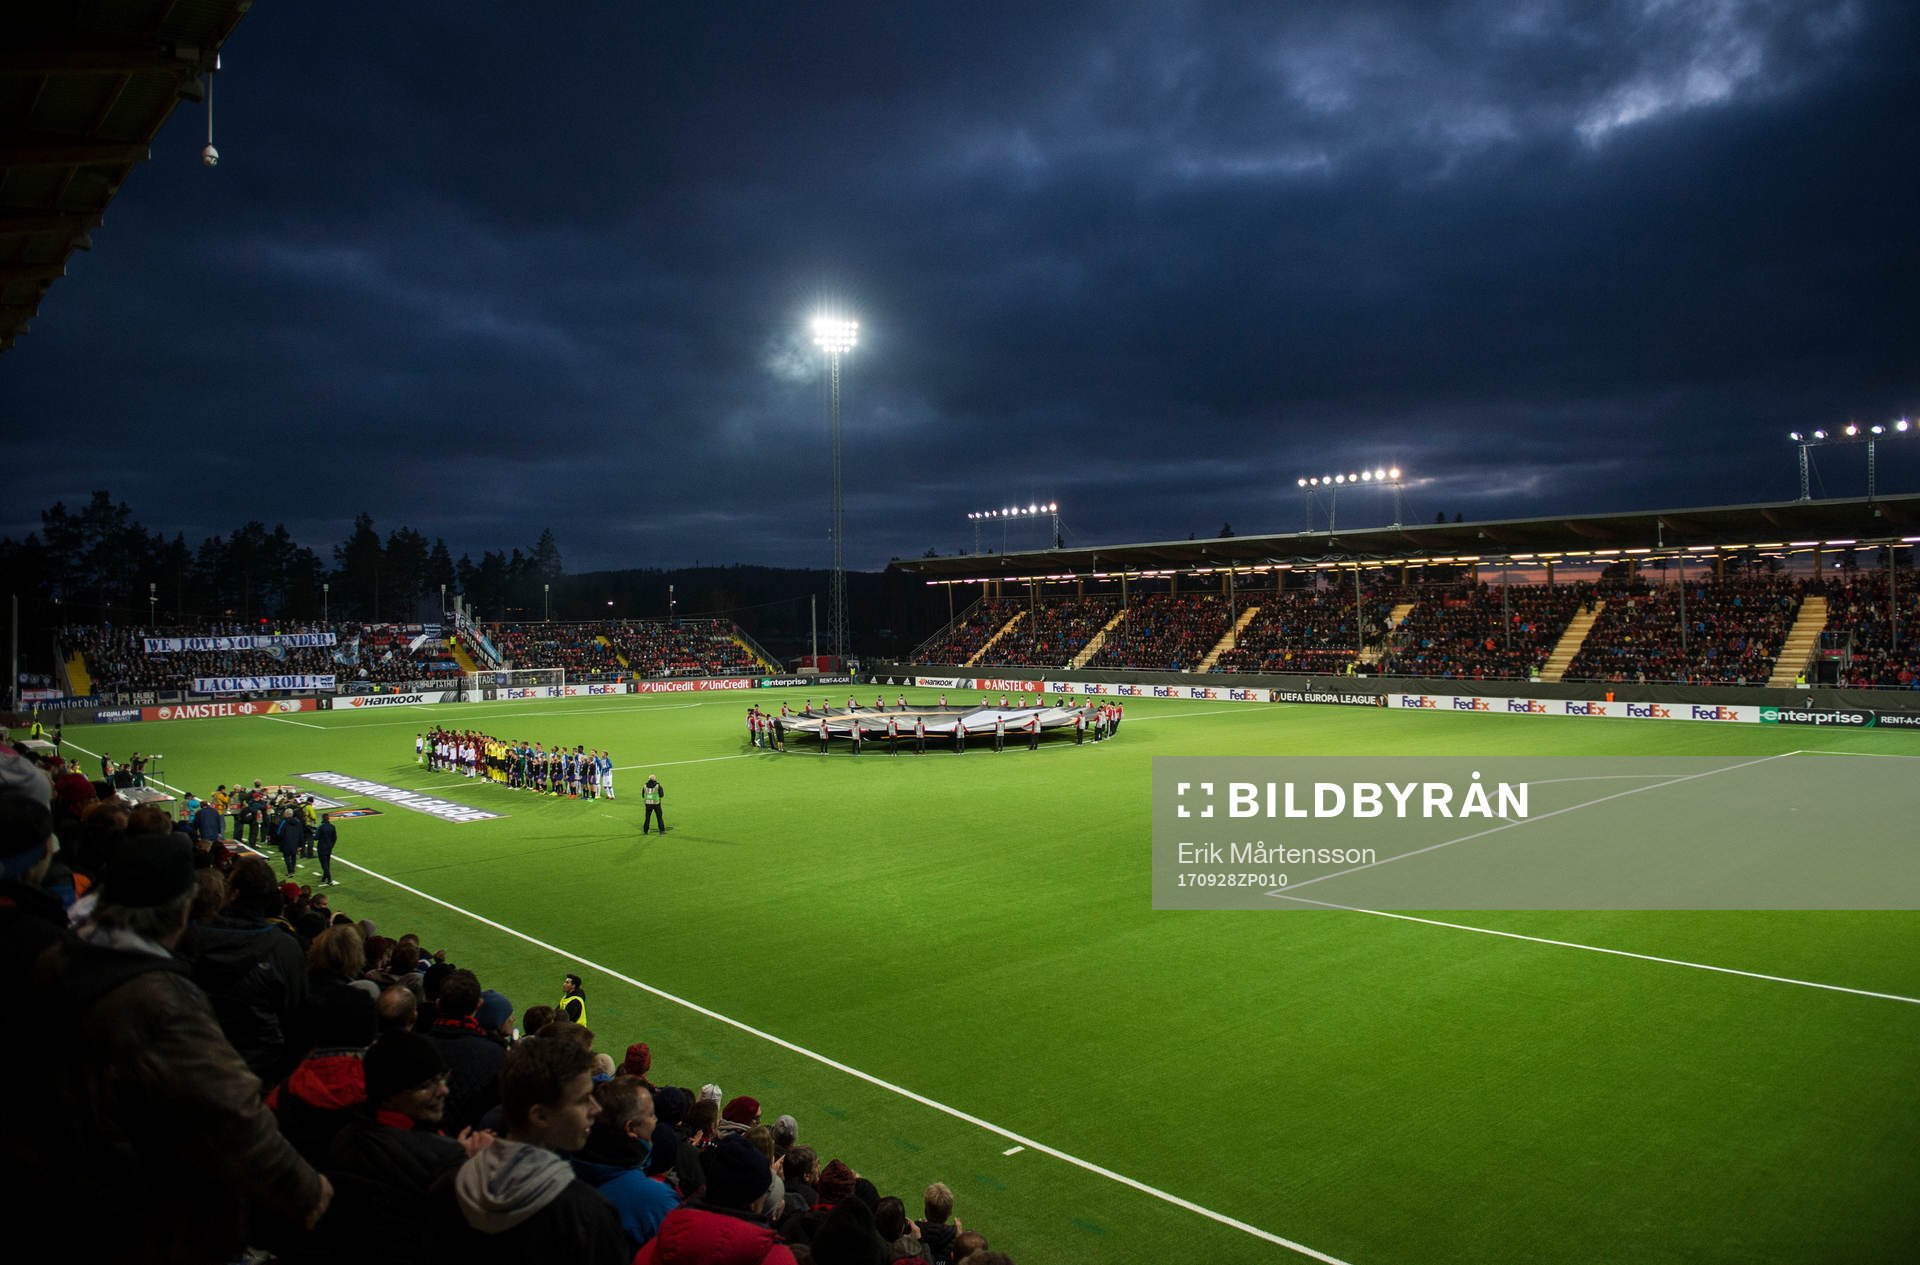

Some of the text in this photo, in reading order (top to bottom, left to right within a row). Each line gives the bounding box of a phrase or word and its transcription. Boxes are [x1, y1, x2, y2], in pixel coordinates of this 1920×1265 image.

[148, 638, 171, 650] WE
[181, 637, 222, 650] LOVE
[228, 636, 260, 649] YOU
[652, 682, 694, 692] UniCredit
[710, 680, 749, 690] UniCredit
[762, 678, 807, 688] enterprise
[992, 680, 1023, 692] AMSTEL
[1052, 683, 1074, 693] FedEx
[508, 688, 536, 698] FedEx
[588, 685, 616, 694] FedEx
[1084, 684, 1107, 694] FedEx
[1118, 686, 1142, 696] FedEx
[1154, 686, 1178, 697] FedEx
[1191, 688, 1216, 699] FedEx
[1230, 688, 1256, 701] FedEx
[1280, 693, 1376, 704] UEFA EUROPA LEAGUE
[1402, 696, 1437, 708] FedEx
[1454, 697, 1490, 710] FedEx
[174, 703, 236, 719] AMSTEL
[1508, 700, 1546, 714] FedEx
[1566, 702, 1606, 716] FedEx
[1626, 704, 1670, 718] FedEx
[1692, 706, 1739, 720] FedEx
[1762, 709, 1863, 725] enterprise
